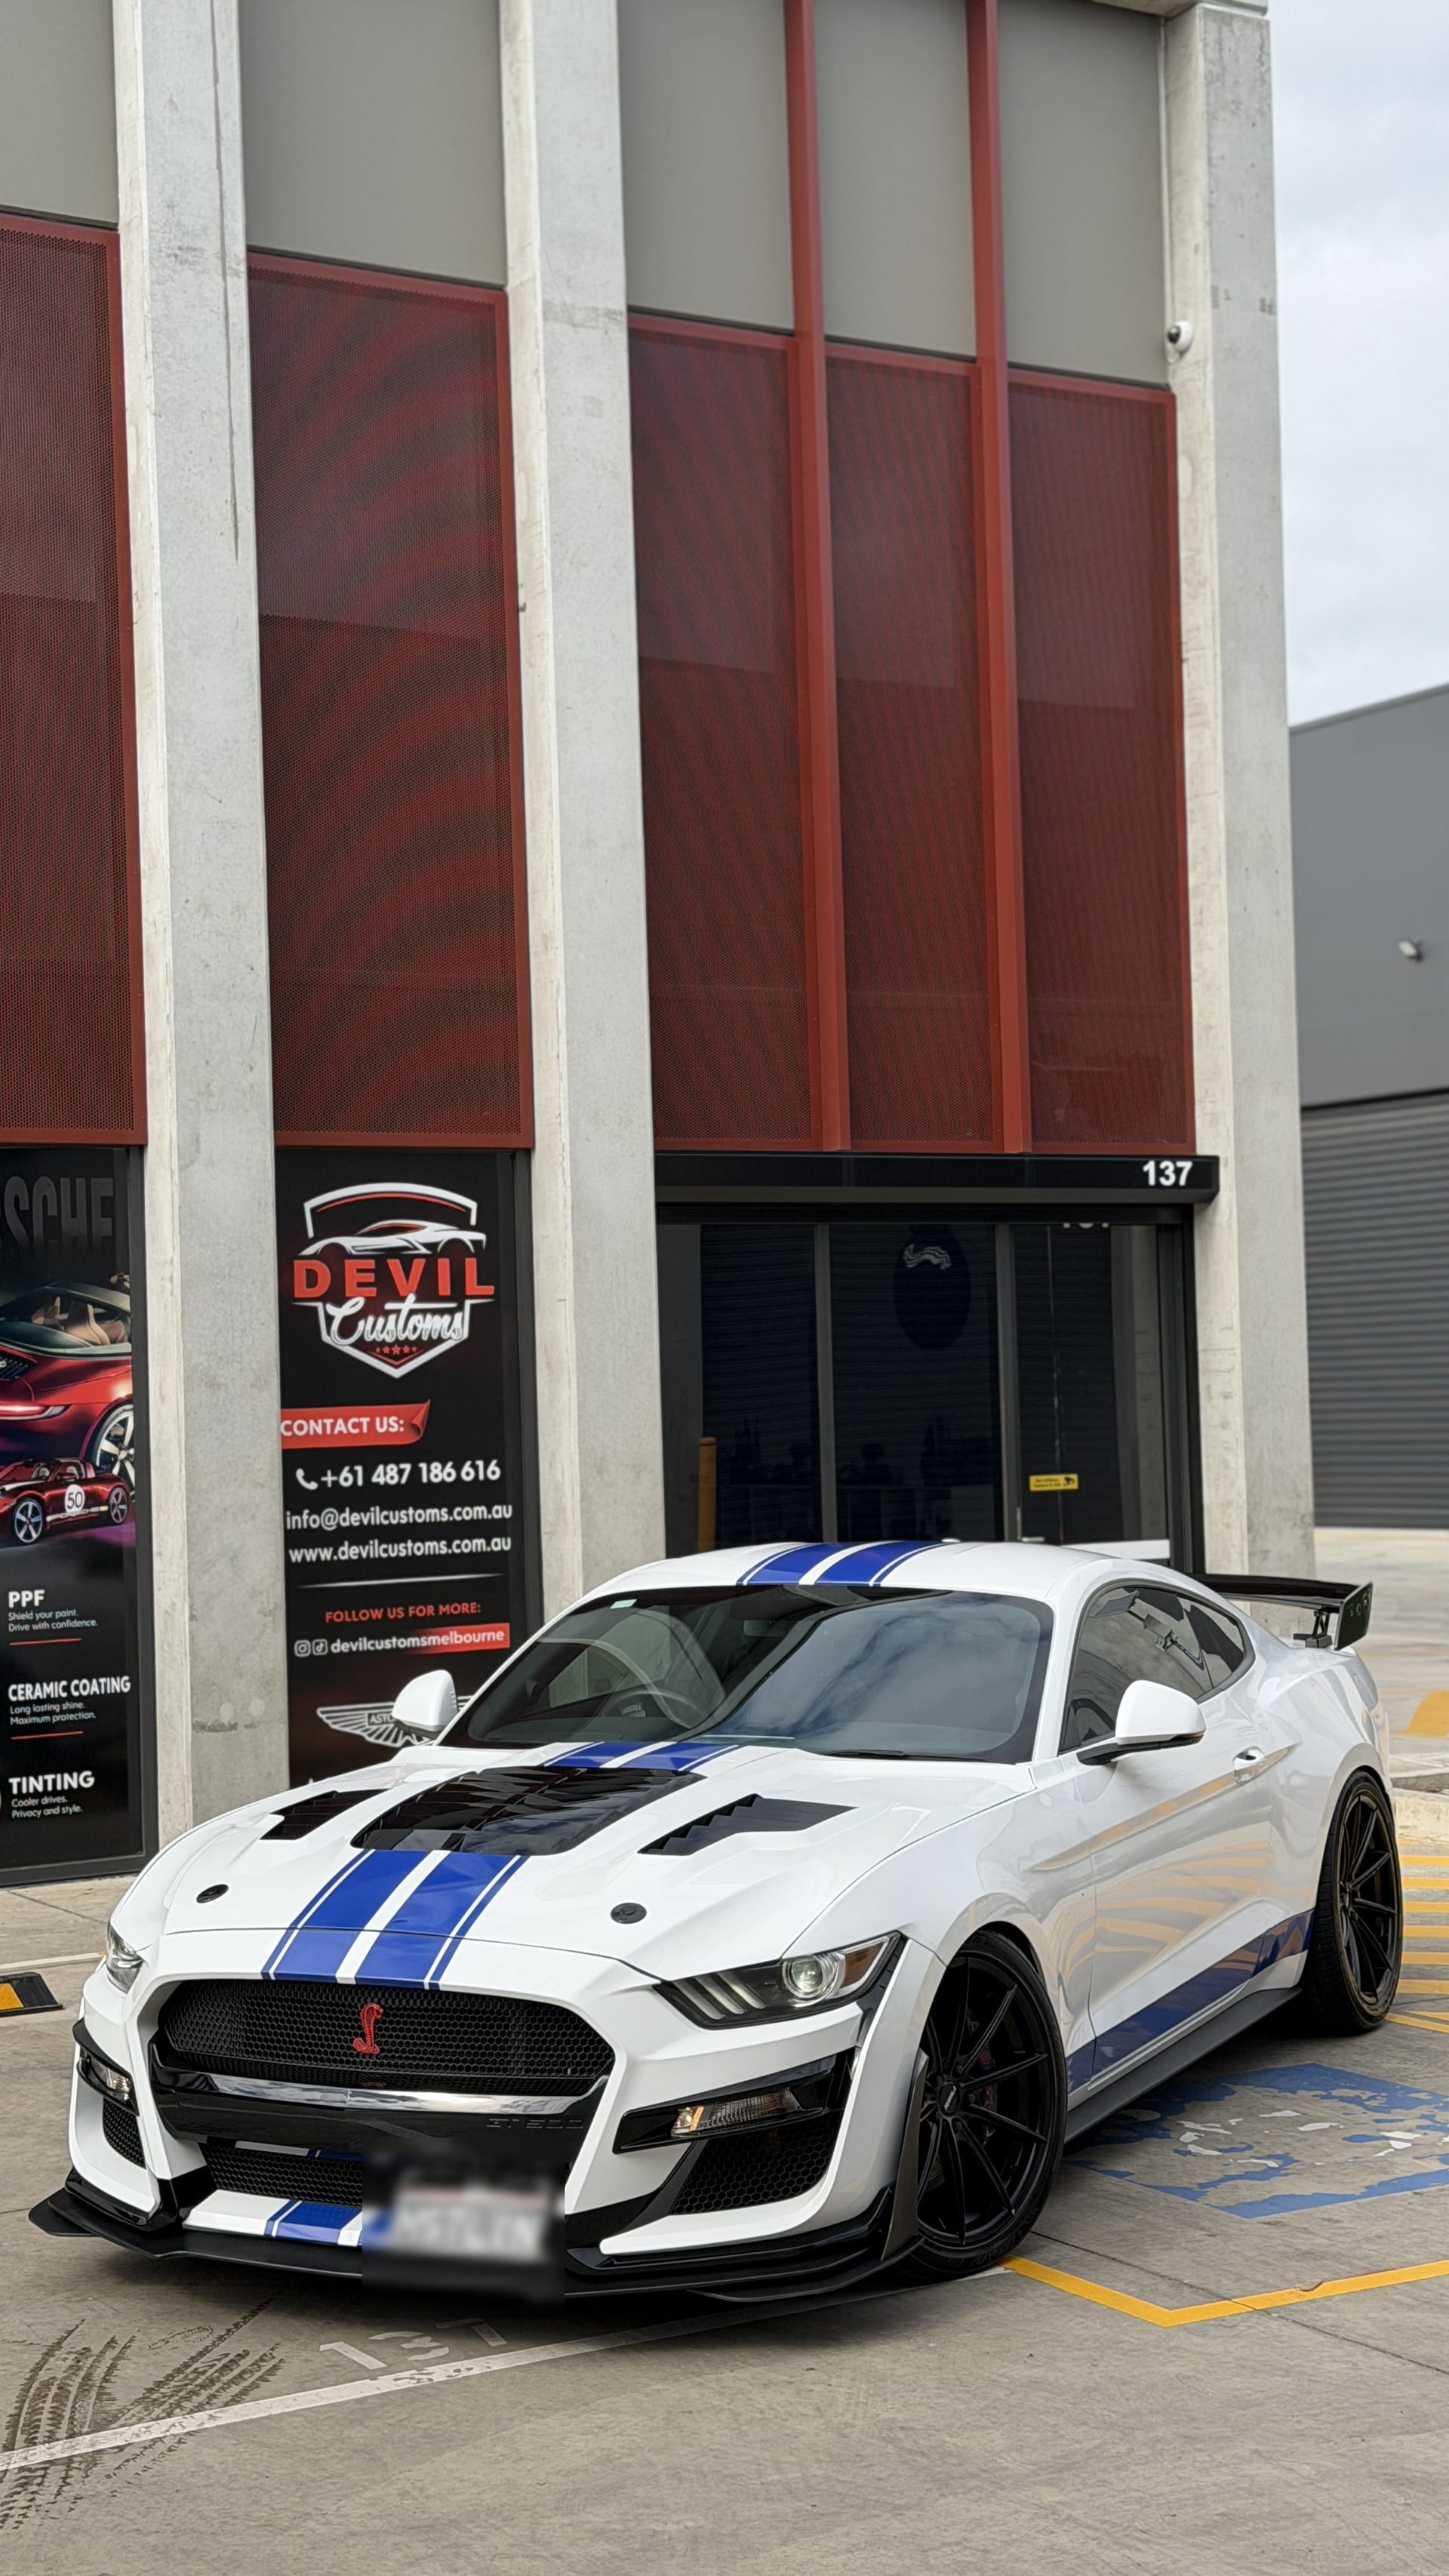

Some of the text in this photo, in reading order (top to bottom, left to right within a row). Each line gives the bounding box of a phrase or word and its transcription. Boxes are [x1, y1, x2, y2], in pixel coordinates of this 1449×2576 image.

[1143, 1160, 1193, 1186] 137
[293, 1257, 494, 1298] DEVIL
[325, 1293, 463, 1346] Customs
[281, 1415, 405, 1436] CONTACT US:
[321, 1459, 501, 1488] +61 487 186 616
[67, 1491, 83, 1510] 50
[286, 1504, 513, 1531] info@devilcustoms.com.au
[288, 1536, 512, 1563] www.devilcustoms.com.au
[8, 1589, 45, 1608] PPF
[8, 1611, 34, 1621] Shield
[35, 1611, 54, 1620] your
[325, 1602, 481, 1623] FOLLOW US FOR MORE:
[8, 1622, 30, 1633] Drive
[32, 1621, 50, 1630] with
[331, 1630, 506, 1653] devilcustomsmelbourne
[8, 1676, 131, 1701] CERAMIC COATING
[10, 1705, 31, 1715] Long
[32, 1703, 60, 1713] lasting
[10, 1715, 51, 1725] Maximum
[8, 1771, 95, 1795] TINTING
[11, 1798, 39, 1807] Cooler
[11, 1808, 42, 1819] Privacy
[43, 1805, 60, 1815] and
[318, 2318, 508, 2369] 137
